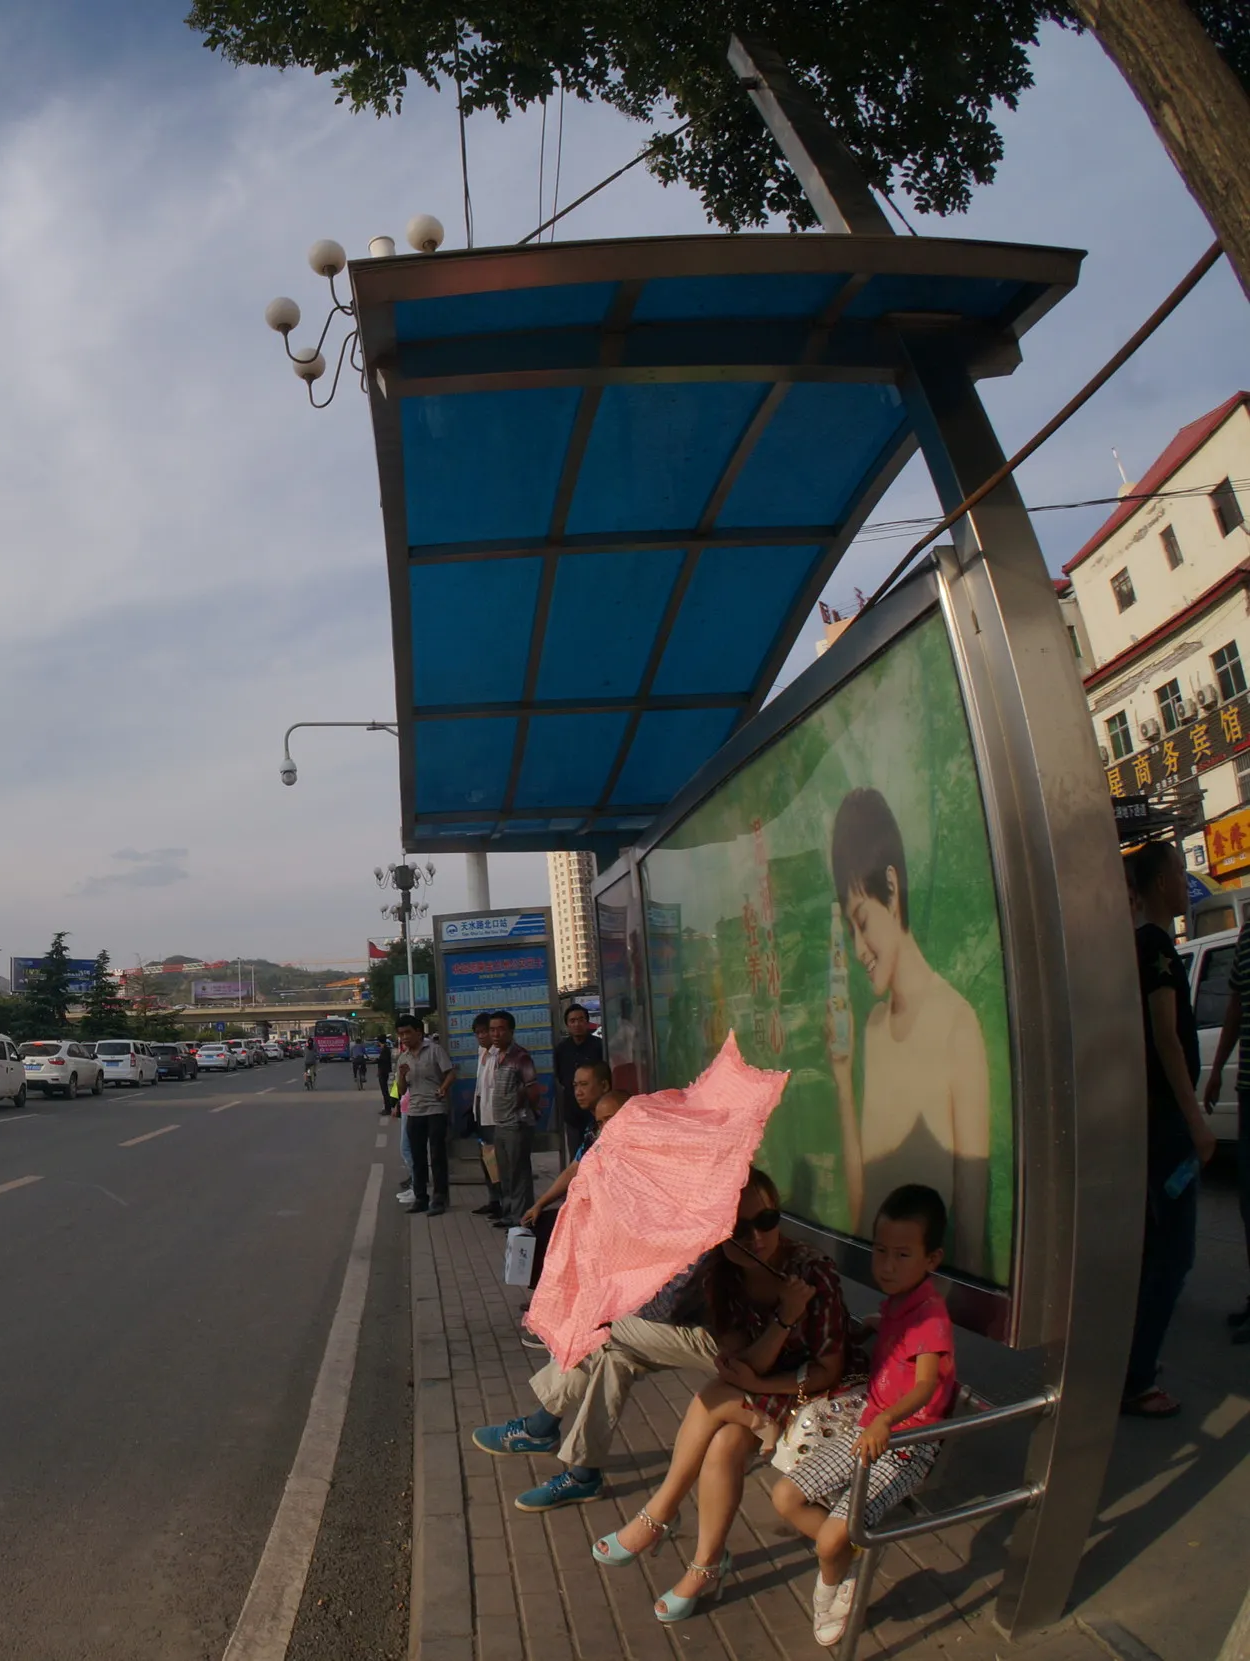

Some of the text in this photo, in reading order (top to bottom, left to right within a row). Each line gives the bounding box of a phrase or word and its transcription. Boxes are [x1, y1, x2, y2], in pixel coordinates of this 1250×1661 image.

[461, 918, 508, 931] 天水路北口站
